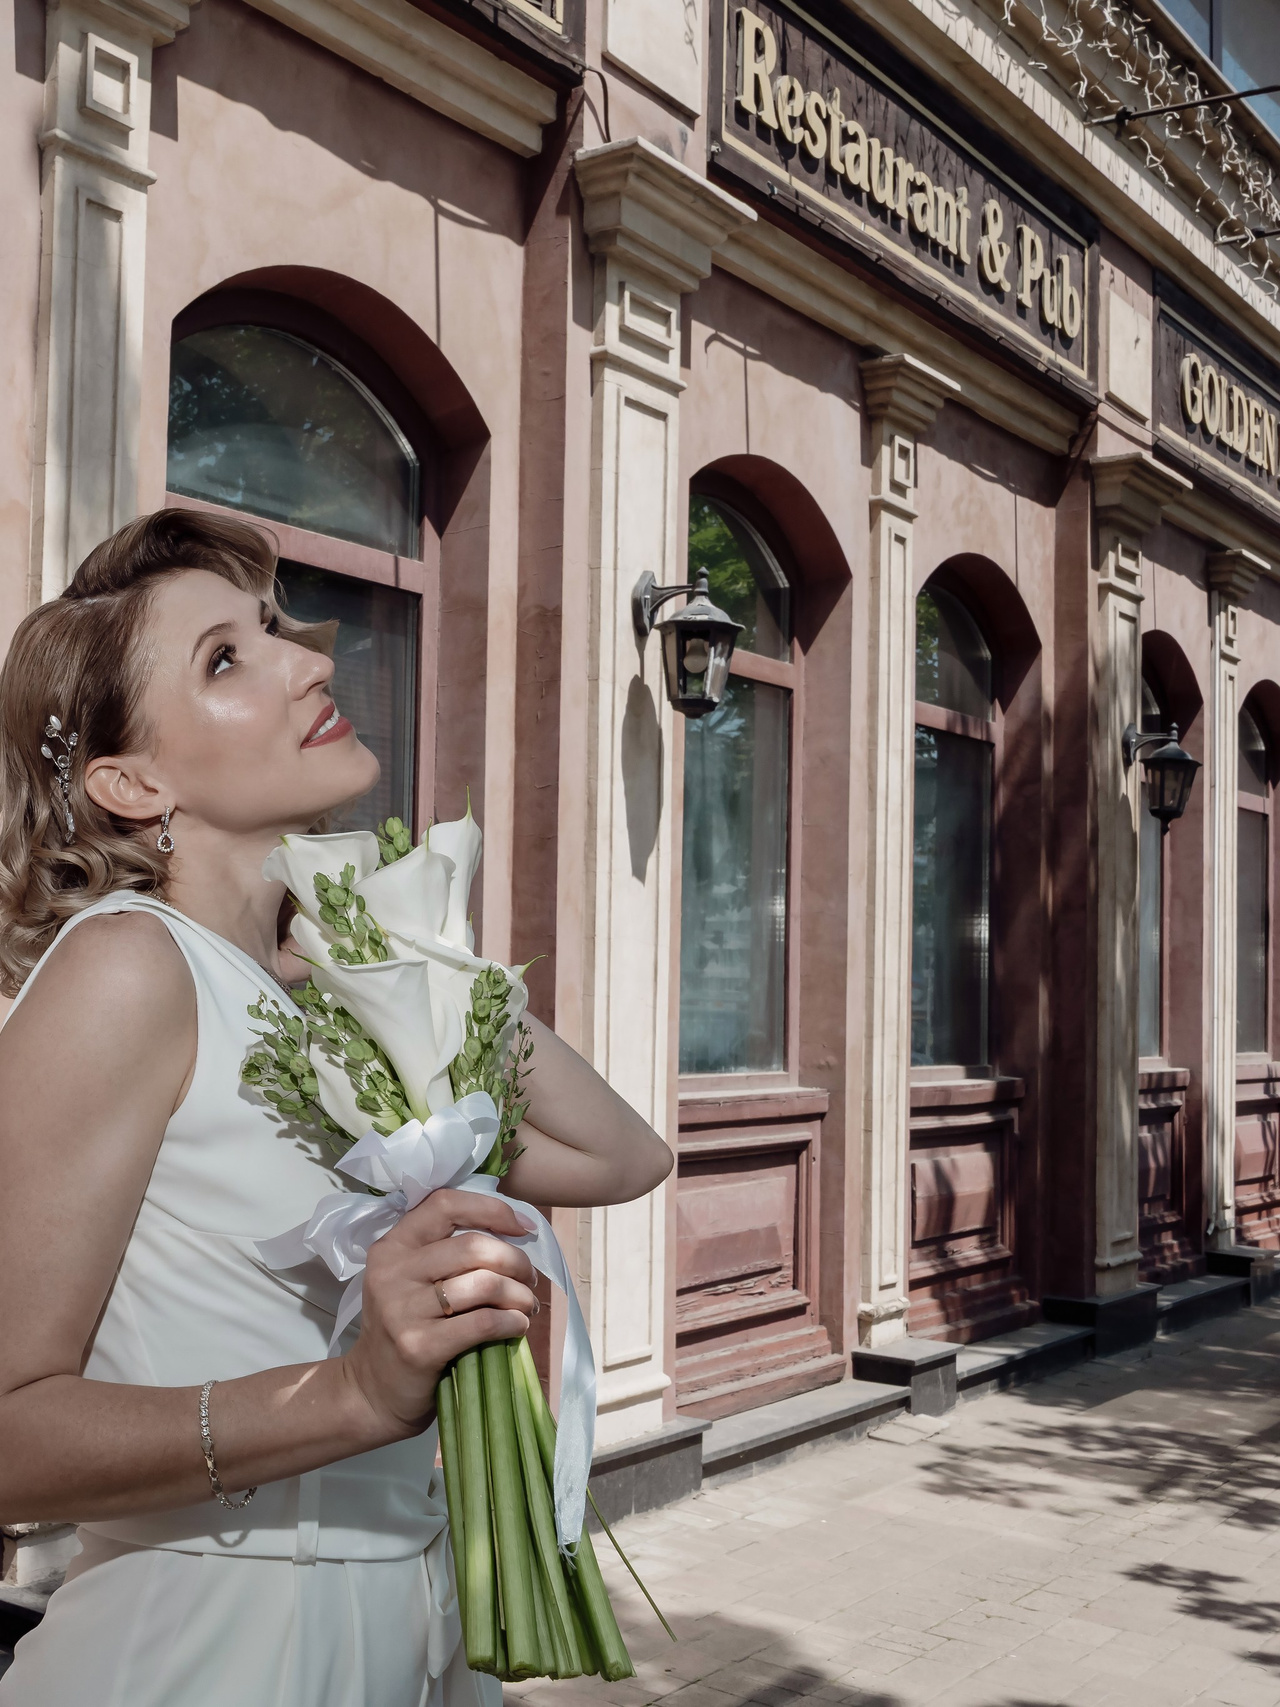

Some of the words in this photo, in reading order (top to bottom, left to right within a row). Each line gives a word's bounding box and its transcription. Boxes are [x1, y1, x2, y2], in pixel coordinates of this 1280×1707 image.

[735, 7, 971, 265] Restaurant
[979, 199, 1011, 292] &
[1017, 224, 1081, 339] Pub
[1180, 353, 1276, 476] GOLDEN
